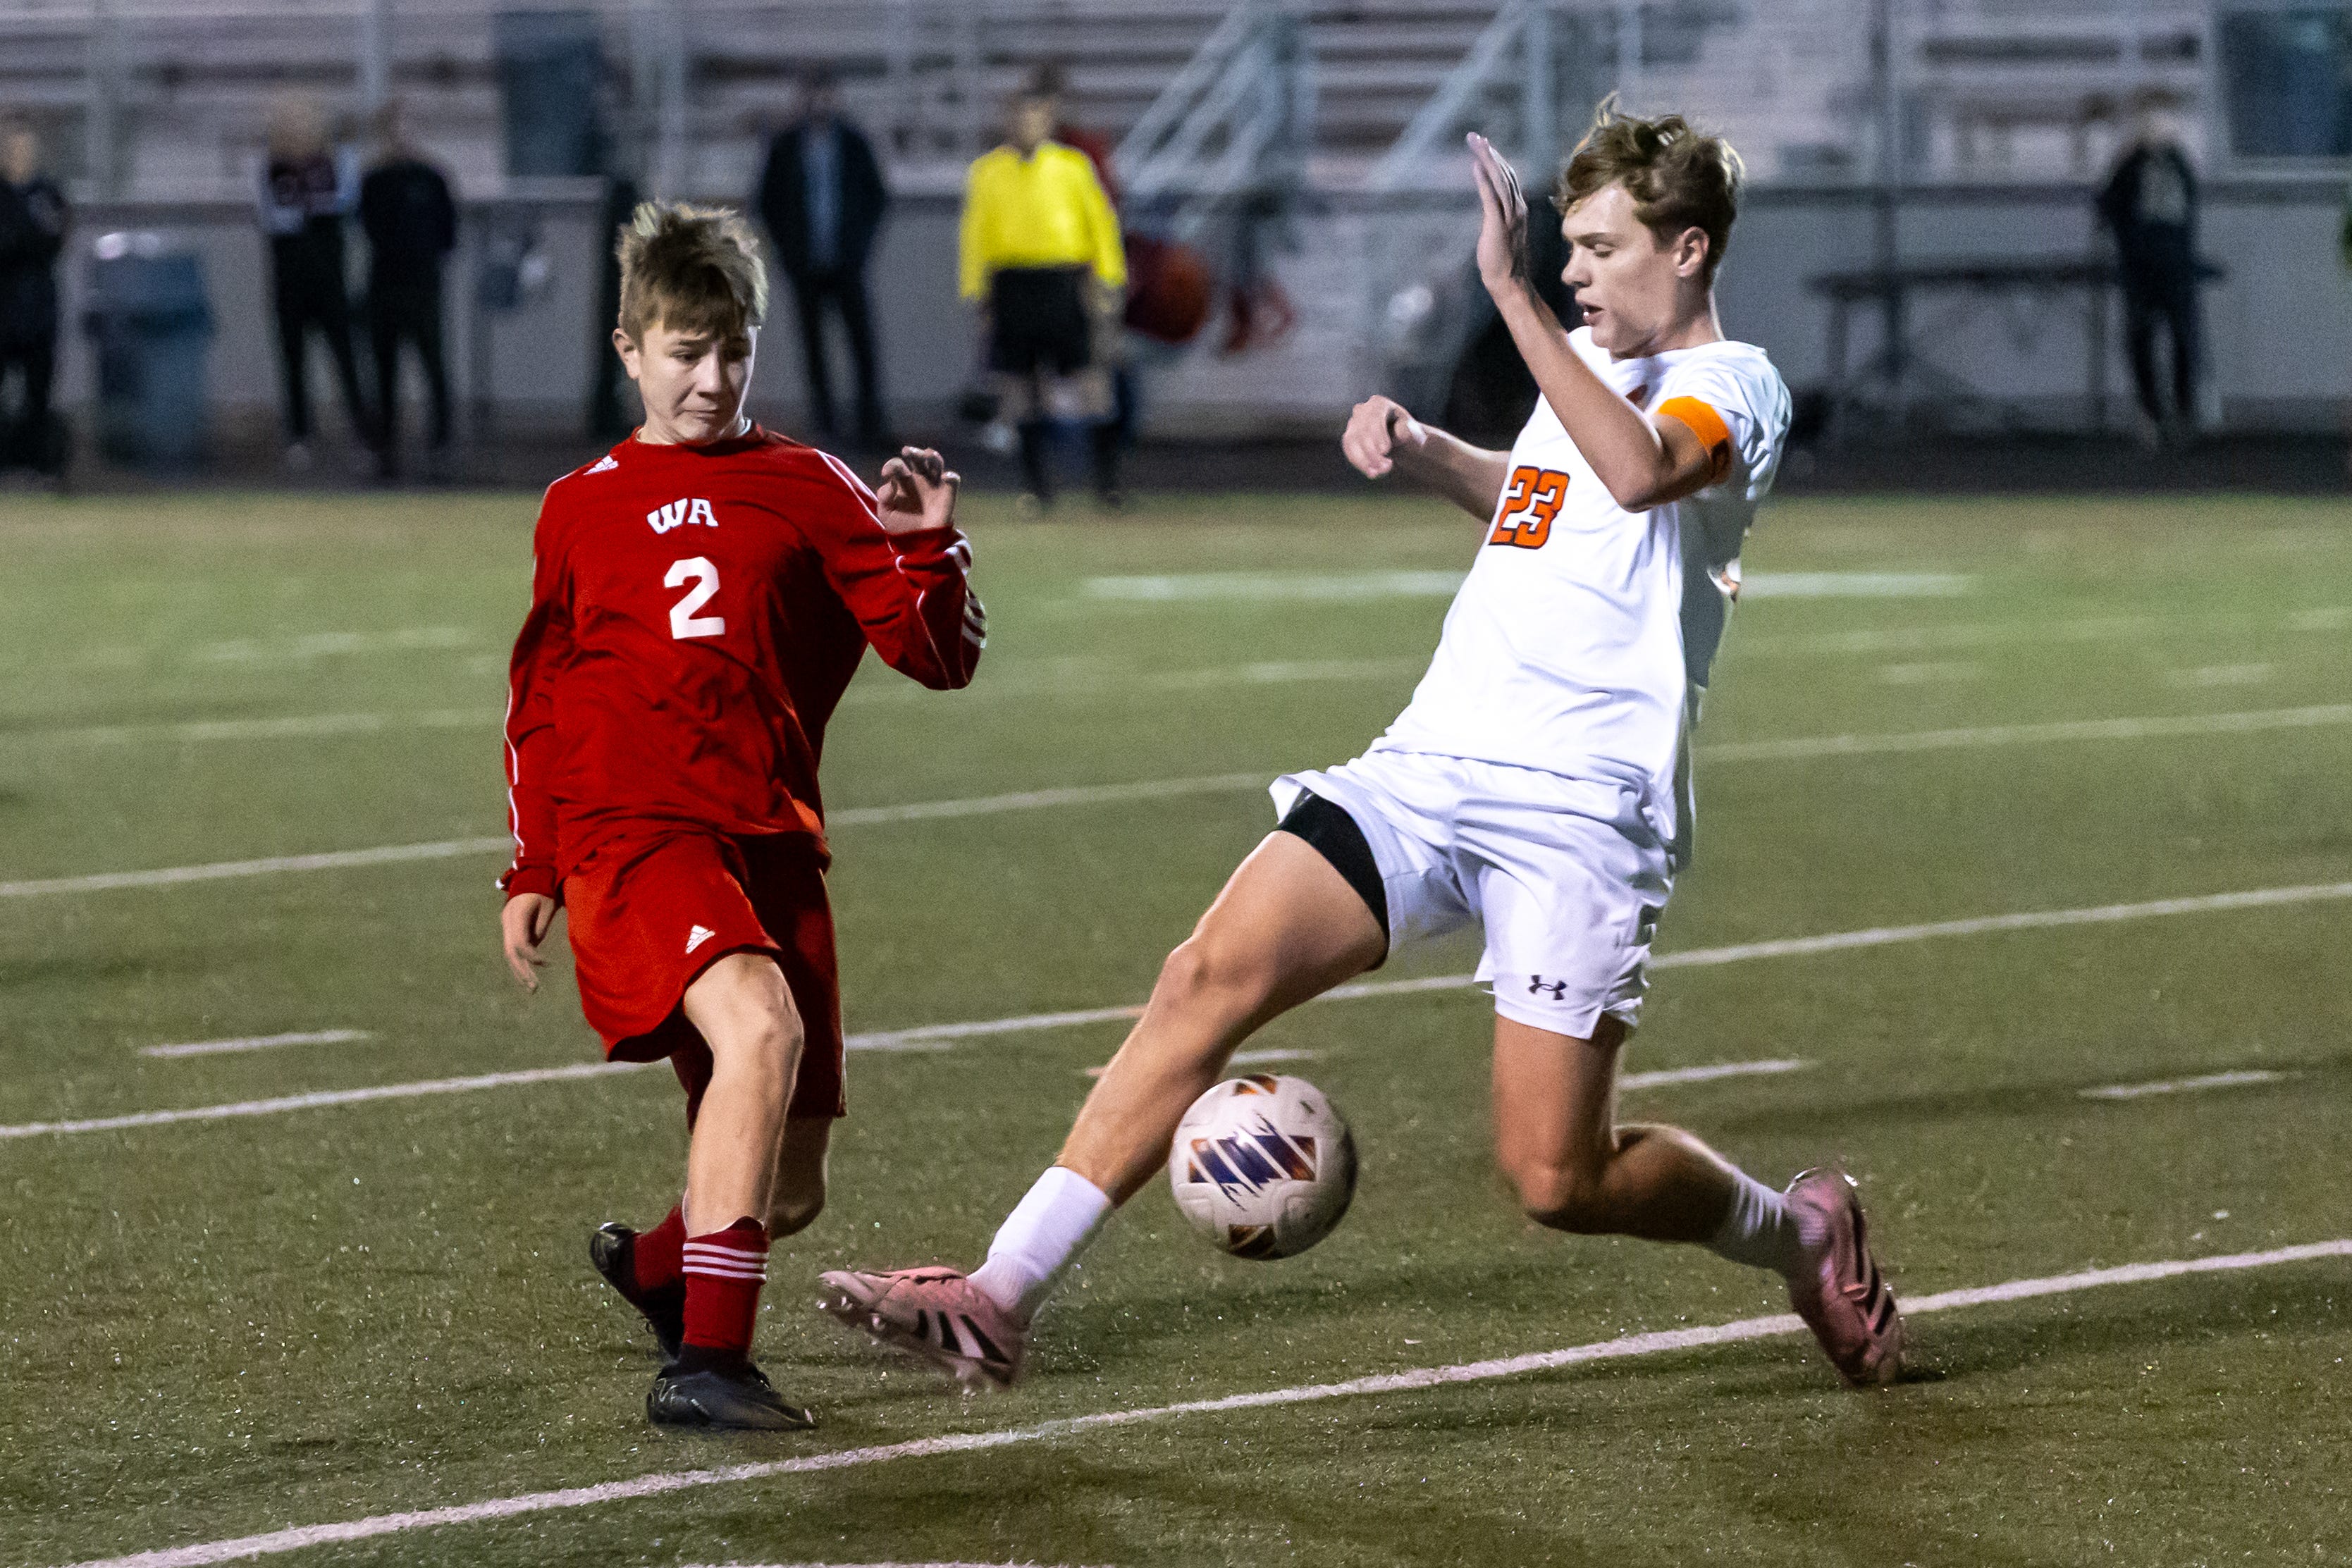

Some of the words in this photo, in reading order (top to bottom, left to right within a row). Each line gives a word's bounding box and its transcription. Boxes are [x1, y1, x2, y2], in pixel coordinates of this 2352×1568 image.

[646, 498, 719, 534] WA
[1488, 465, 1570, 550] 23
[663, 556, 725, 640] 2
